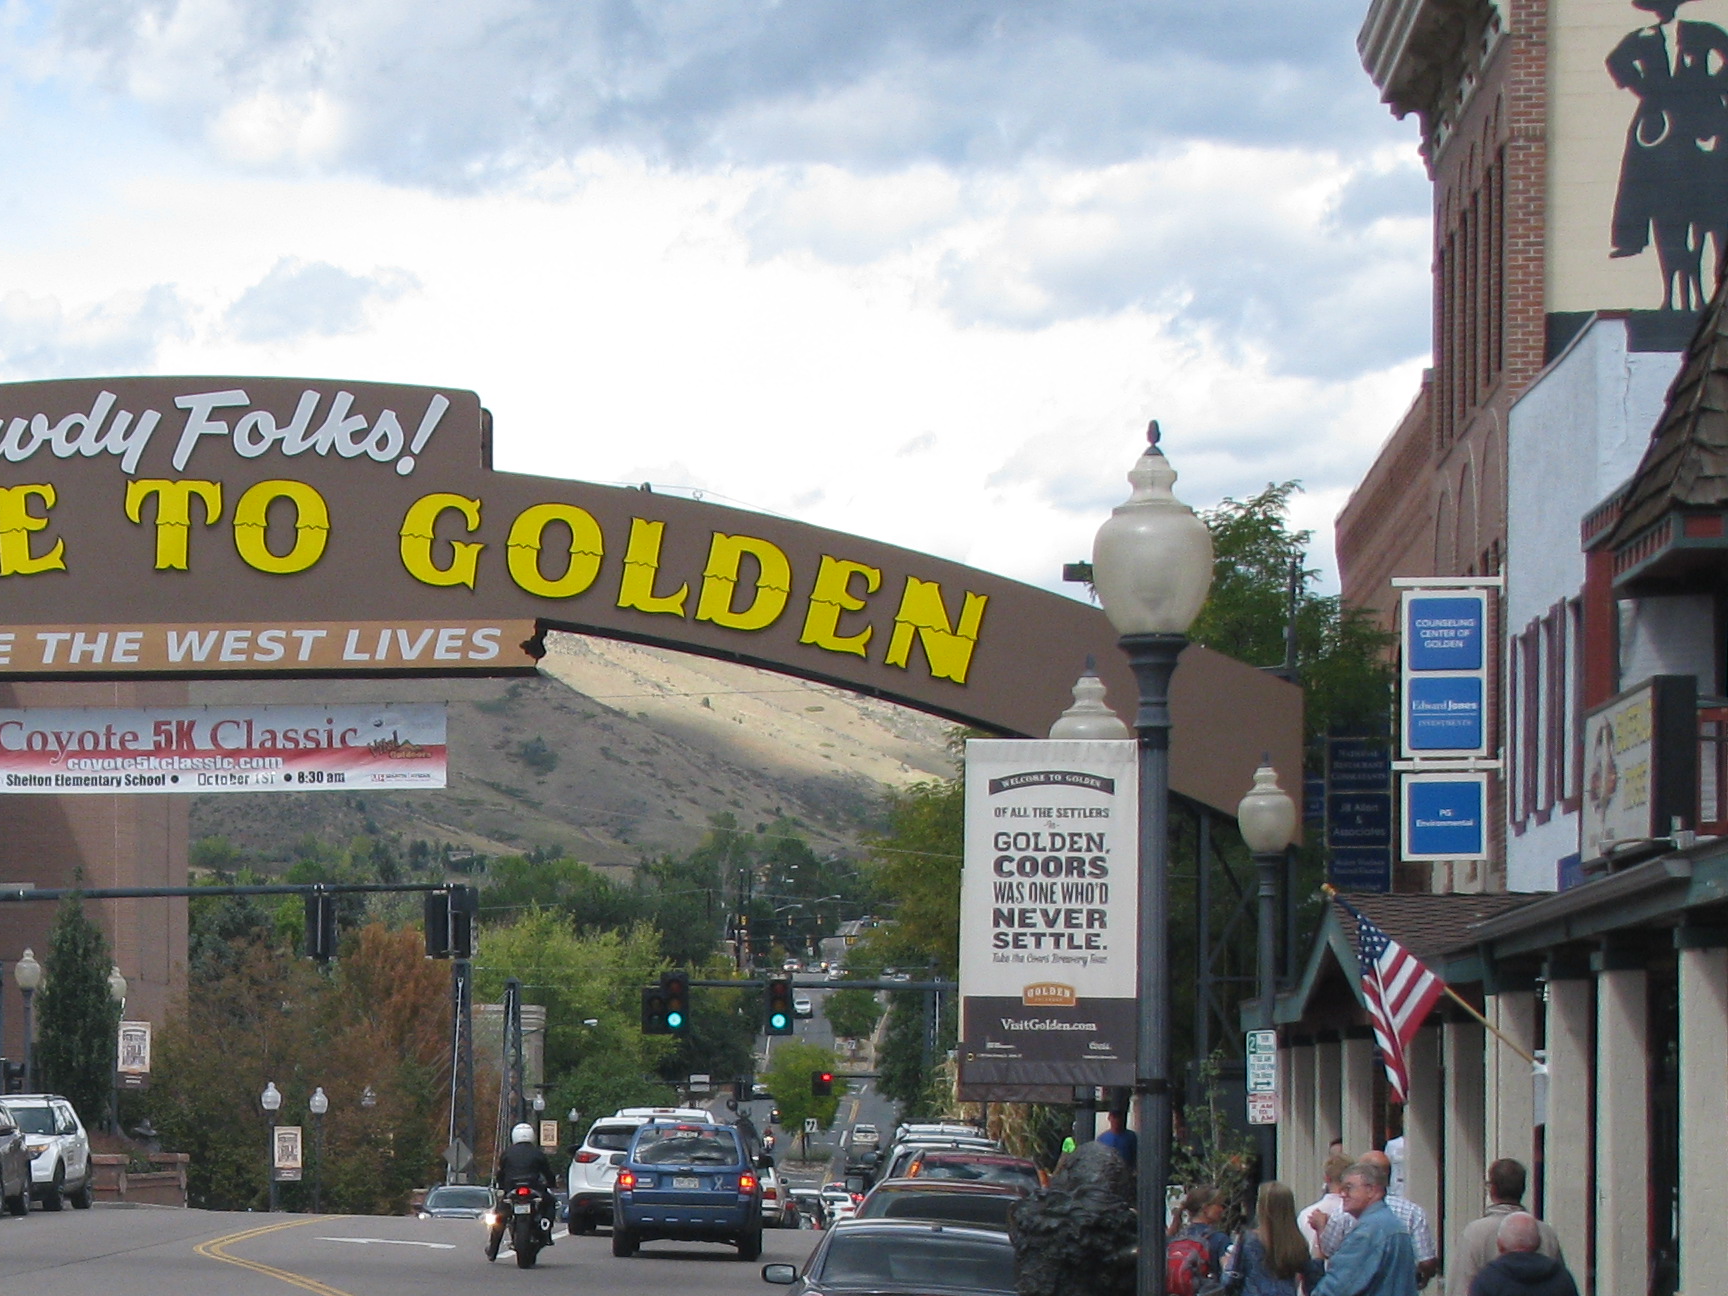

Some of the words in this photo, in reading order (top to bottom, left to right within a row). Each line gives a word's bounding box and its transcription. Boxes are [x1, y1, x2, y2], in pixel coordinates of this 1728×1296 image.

[172, 387, 450, 476] Folks!
[123, 478, 331, 575] TO
[398, 492, 988, 686] GOLDEN
[1415, 618, 1475, 628] COUNSELING
[1420, 629, 1456, 638] CENTER
[1457, 629, 1471, 638] OF
[35, 631, 145, 665] THE
[168, 629, 328, 664] WEST
[341, 627, 502, 662] LIVES
[1424, 639, 1464, 648] GOLDEN
[1412, 700, 1447, 711] Edward
[1448, 700, 1478, 711] Jones
[152, 719, 197, 751] 5K
[210, 718, 358, 750] Classic
[65, 755, 285, 773] coyote5kclassic.com
[6, 773, 52, 787] Shelton
[54, 773, 122, 788] Elementary
[124, 773, 166, 787] School
[197, 772, 250, 787] October
[297, 771, 324, 784] 8:30
[326, 771, 346, 784] am
[1000, 773, 1045, 788] WELCOME
[1049, 773, 1062, 781] TO
[1066, 774, 1102, 788] GOLDEN
[994, 806, 1008, 818] OF
[1010, 806, 1030, 818] ALL
[1032, 806, 1054, 818] THE
[1055, 807, 1111, 819] SETTLERS
[1415, 819, 1474, 828] Environmental
[993, 831, 1111, 854] GOLDEN,
[993, 855, 1109, 879] COORS
[993, 881, 1025, 904] WAS
[1028, 881, 1057, 904] ONE
[1060, 881, 1109, 904] WHO'D
[992, 907, 1108, 929] NEVER
[992, 931, 1108, 950] SETTLE.
[1026, 985, 1072, 998] GOLDEN
[1000, 1018, 1098, 1032] VisitGolden.com
